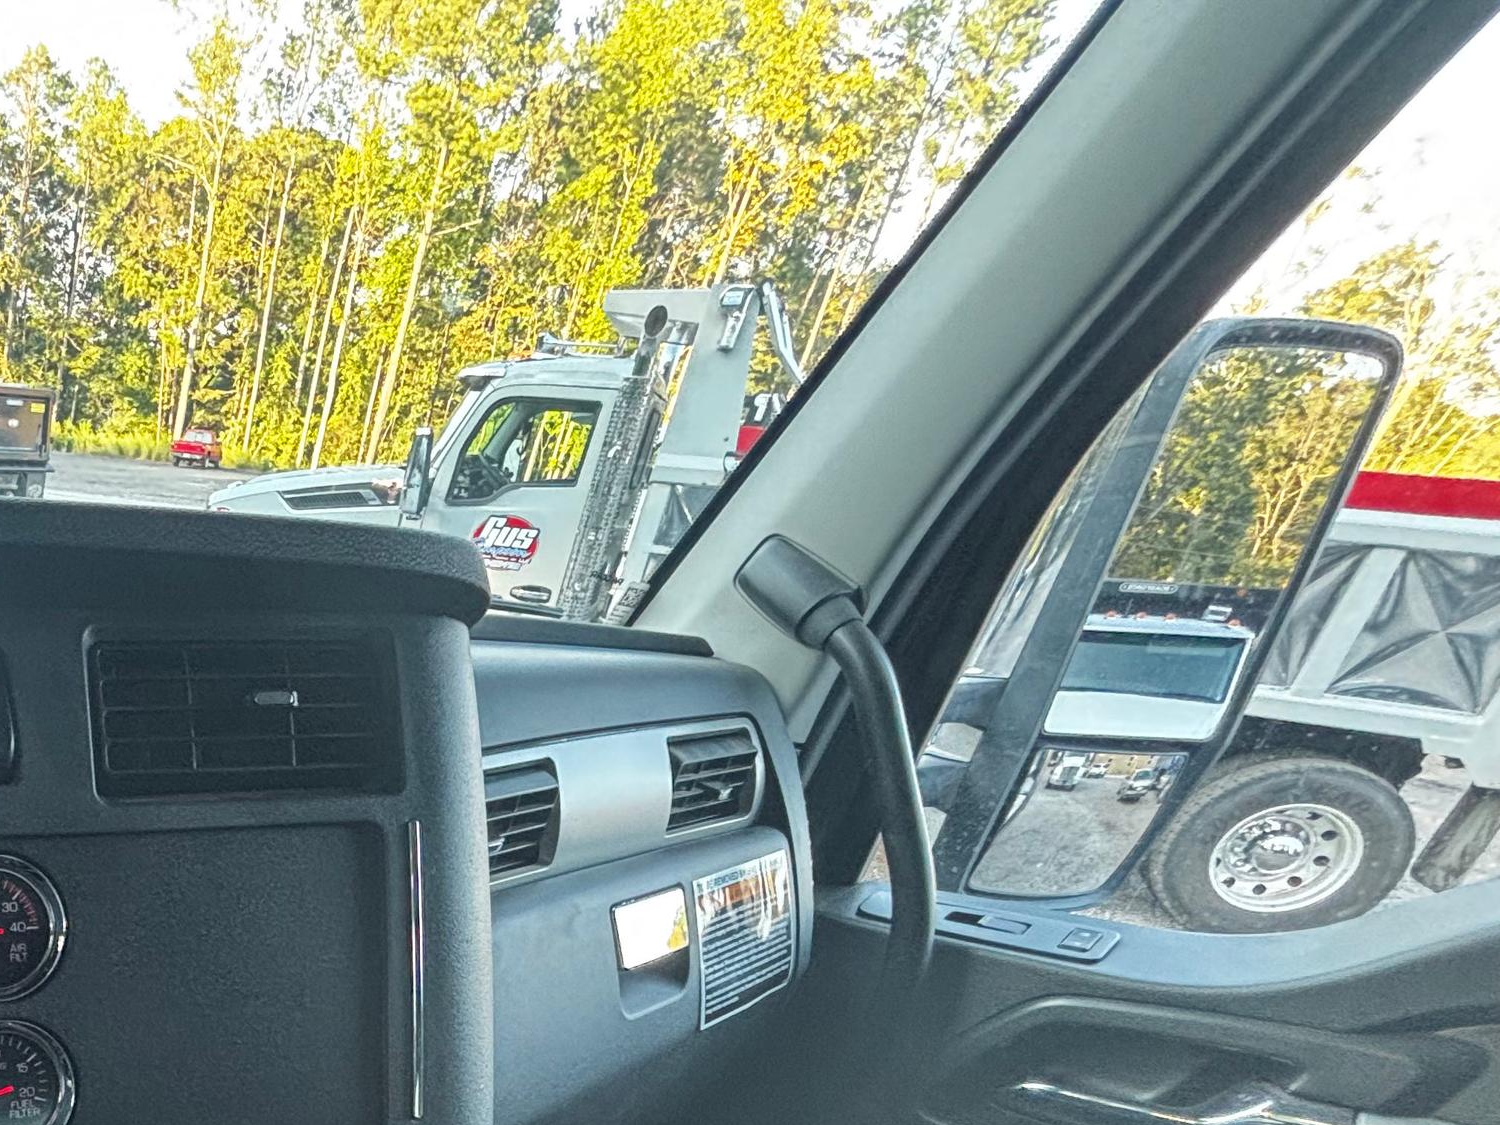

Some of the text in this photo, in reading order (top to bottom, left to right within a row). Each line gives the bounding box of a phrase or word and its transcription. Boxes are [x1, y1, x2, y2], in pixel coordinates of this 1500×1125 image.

[2, 902, 18, 913] 30
[9, 921, 27, 933] 40
[9, 942, 28, 953] AIR
[16, 1063, 29, 1074] 15
[19, 1086, 36, 1098] 20
[10, 1099, 35, 1110] FUEL
[9, 1107, 41, 1120] FILTER
